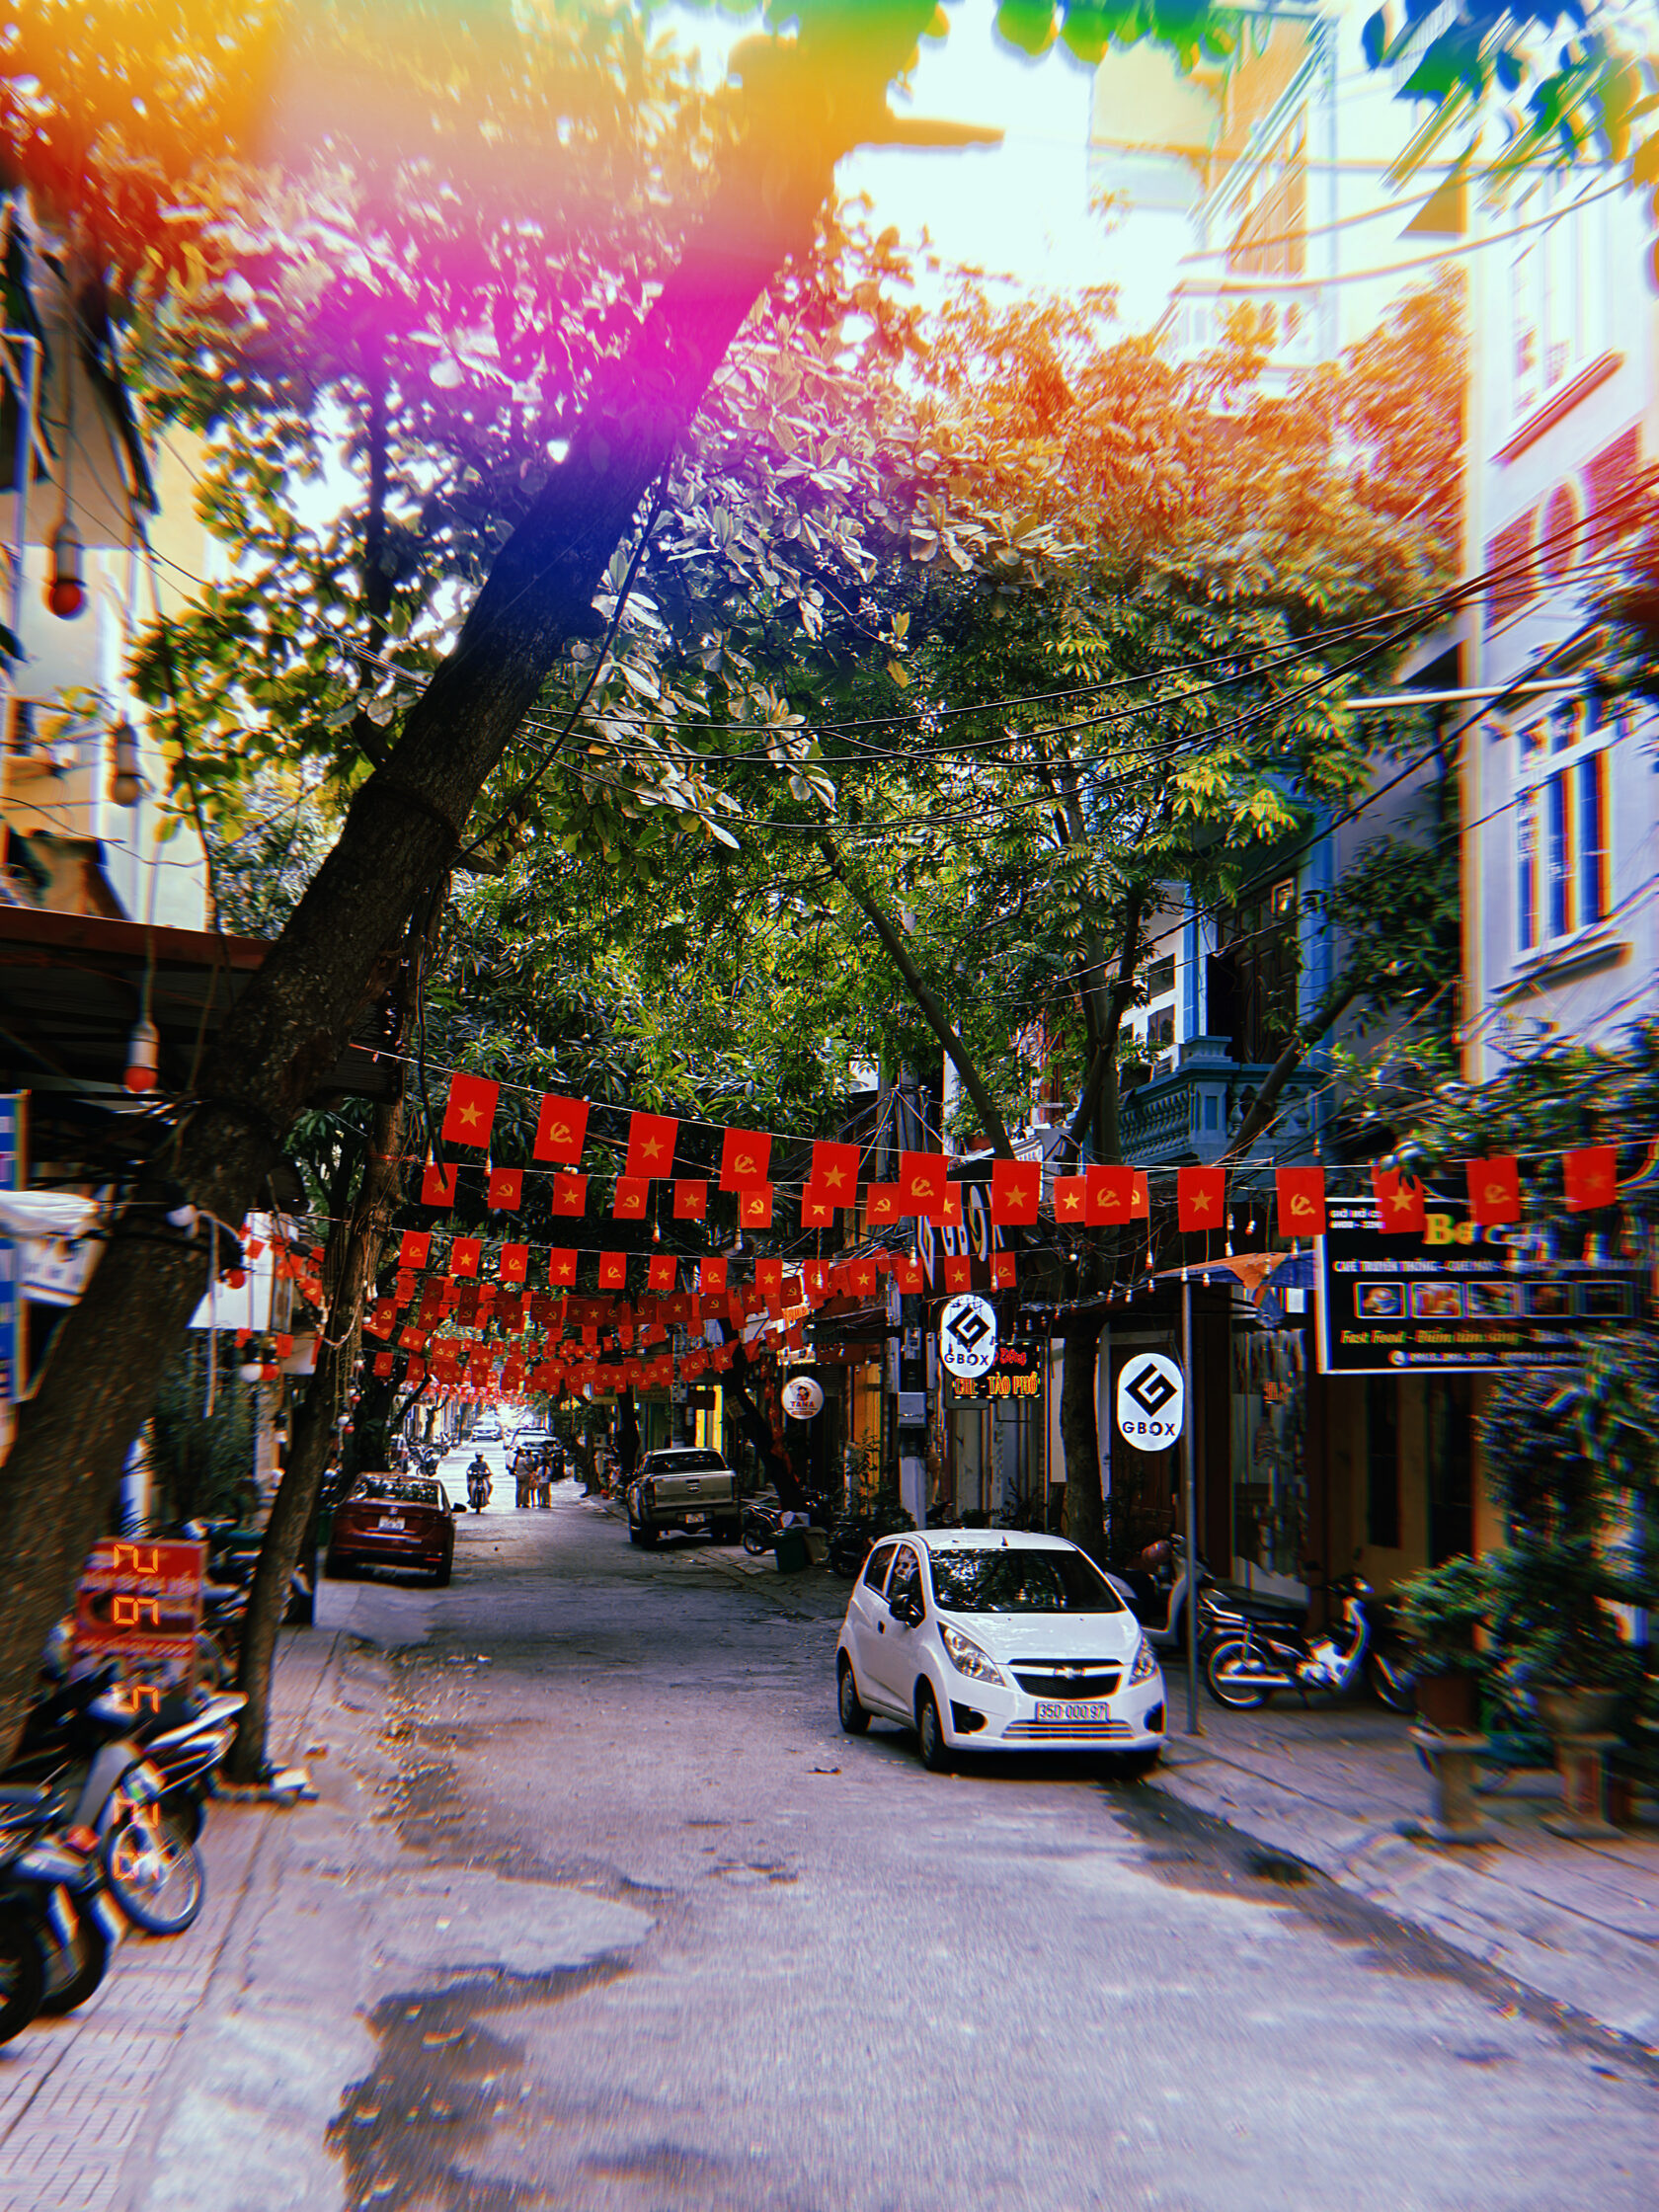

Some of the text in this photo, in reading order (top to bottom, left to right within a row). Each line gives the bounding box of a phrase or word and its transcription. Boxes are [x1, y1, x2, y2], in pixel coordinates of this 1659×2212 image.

[1341, 1329, 1370, 1344] Fast
[1372, 1329, 1406, 1344] Food
[944, 1353, 989, 1366] GBOX
[1122, 1421, 1176, 1436] GBOX
